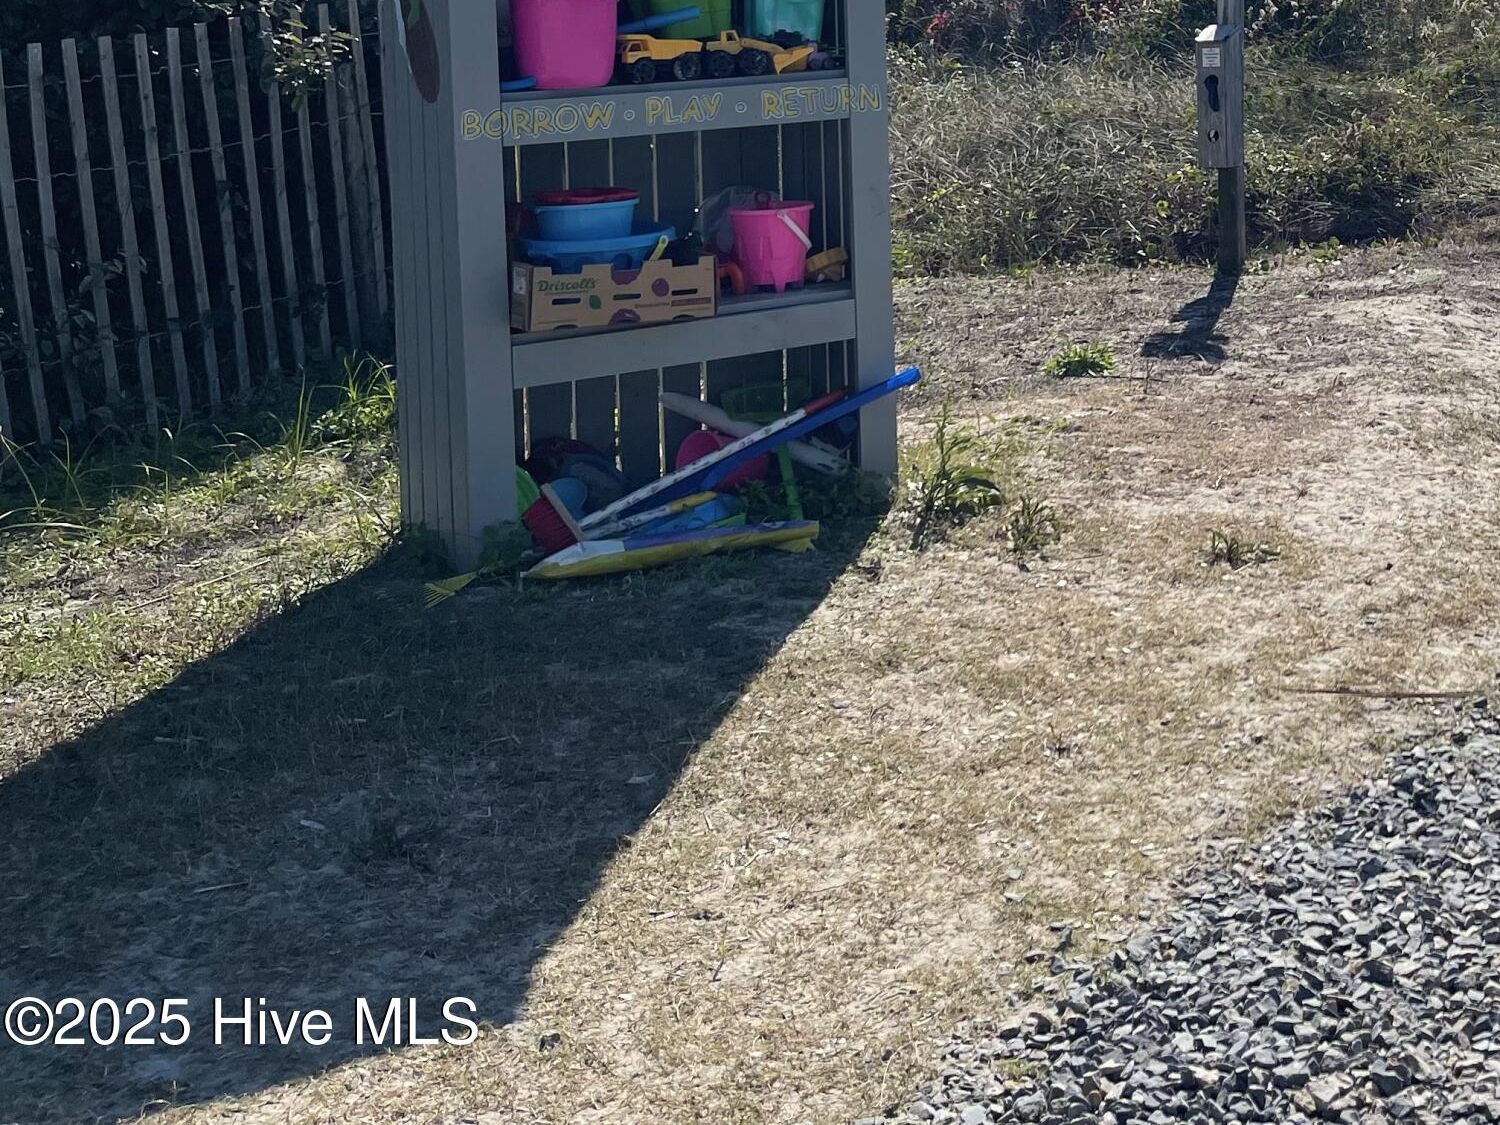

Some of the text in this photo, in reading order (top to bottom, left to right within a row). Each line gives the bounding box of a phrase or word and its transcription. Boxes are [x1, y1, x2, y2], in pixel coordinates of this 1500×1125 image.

[462, 84, 882, 139] BORROW PLAY RETURN
[538, 277, 597, 292] Driscoll's
